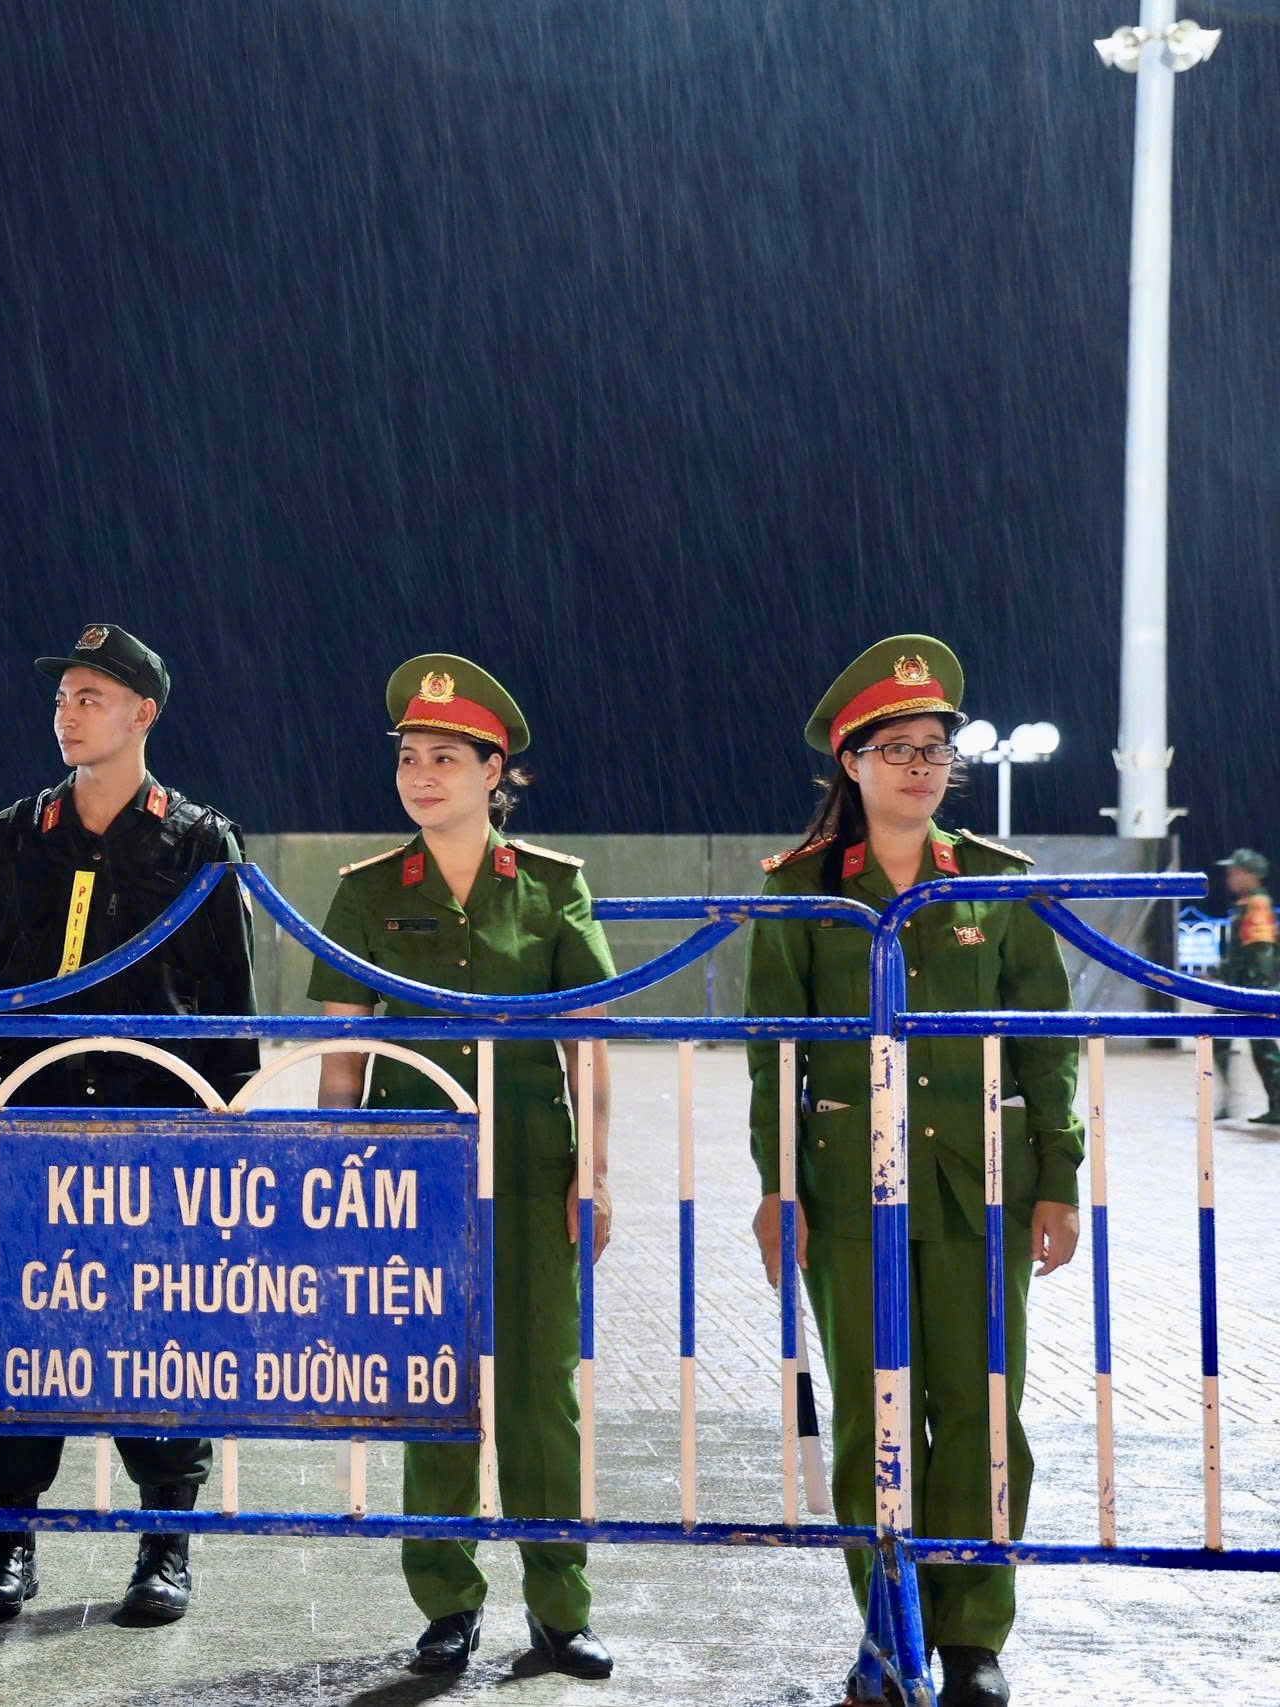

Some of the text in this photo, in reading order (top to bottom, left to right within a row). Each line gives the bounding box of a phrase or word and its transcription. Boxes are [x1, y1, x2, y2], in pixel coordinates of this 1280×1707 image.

[48, 1145, 417, 1240] KHU VỰC CẤM
[21, 1248, 442, 1325] CÁC PHƯƠNG TIỆN
[5, 1347, 92, 1398] GIAO
[106, 1339, 238, 1401] THÔNG
[254, 1339, 388, 1403] ĐƯỜNG
